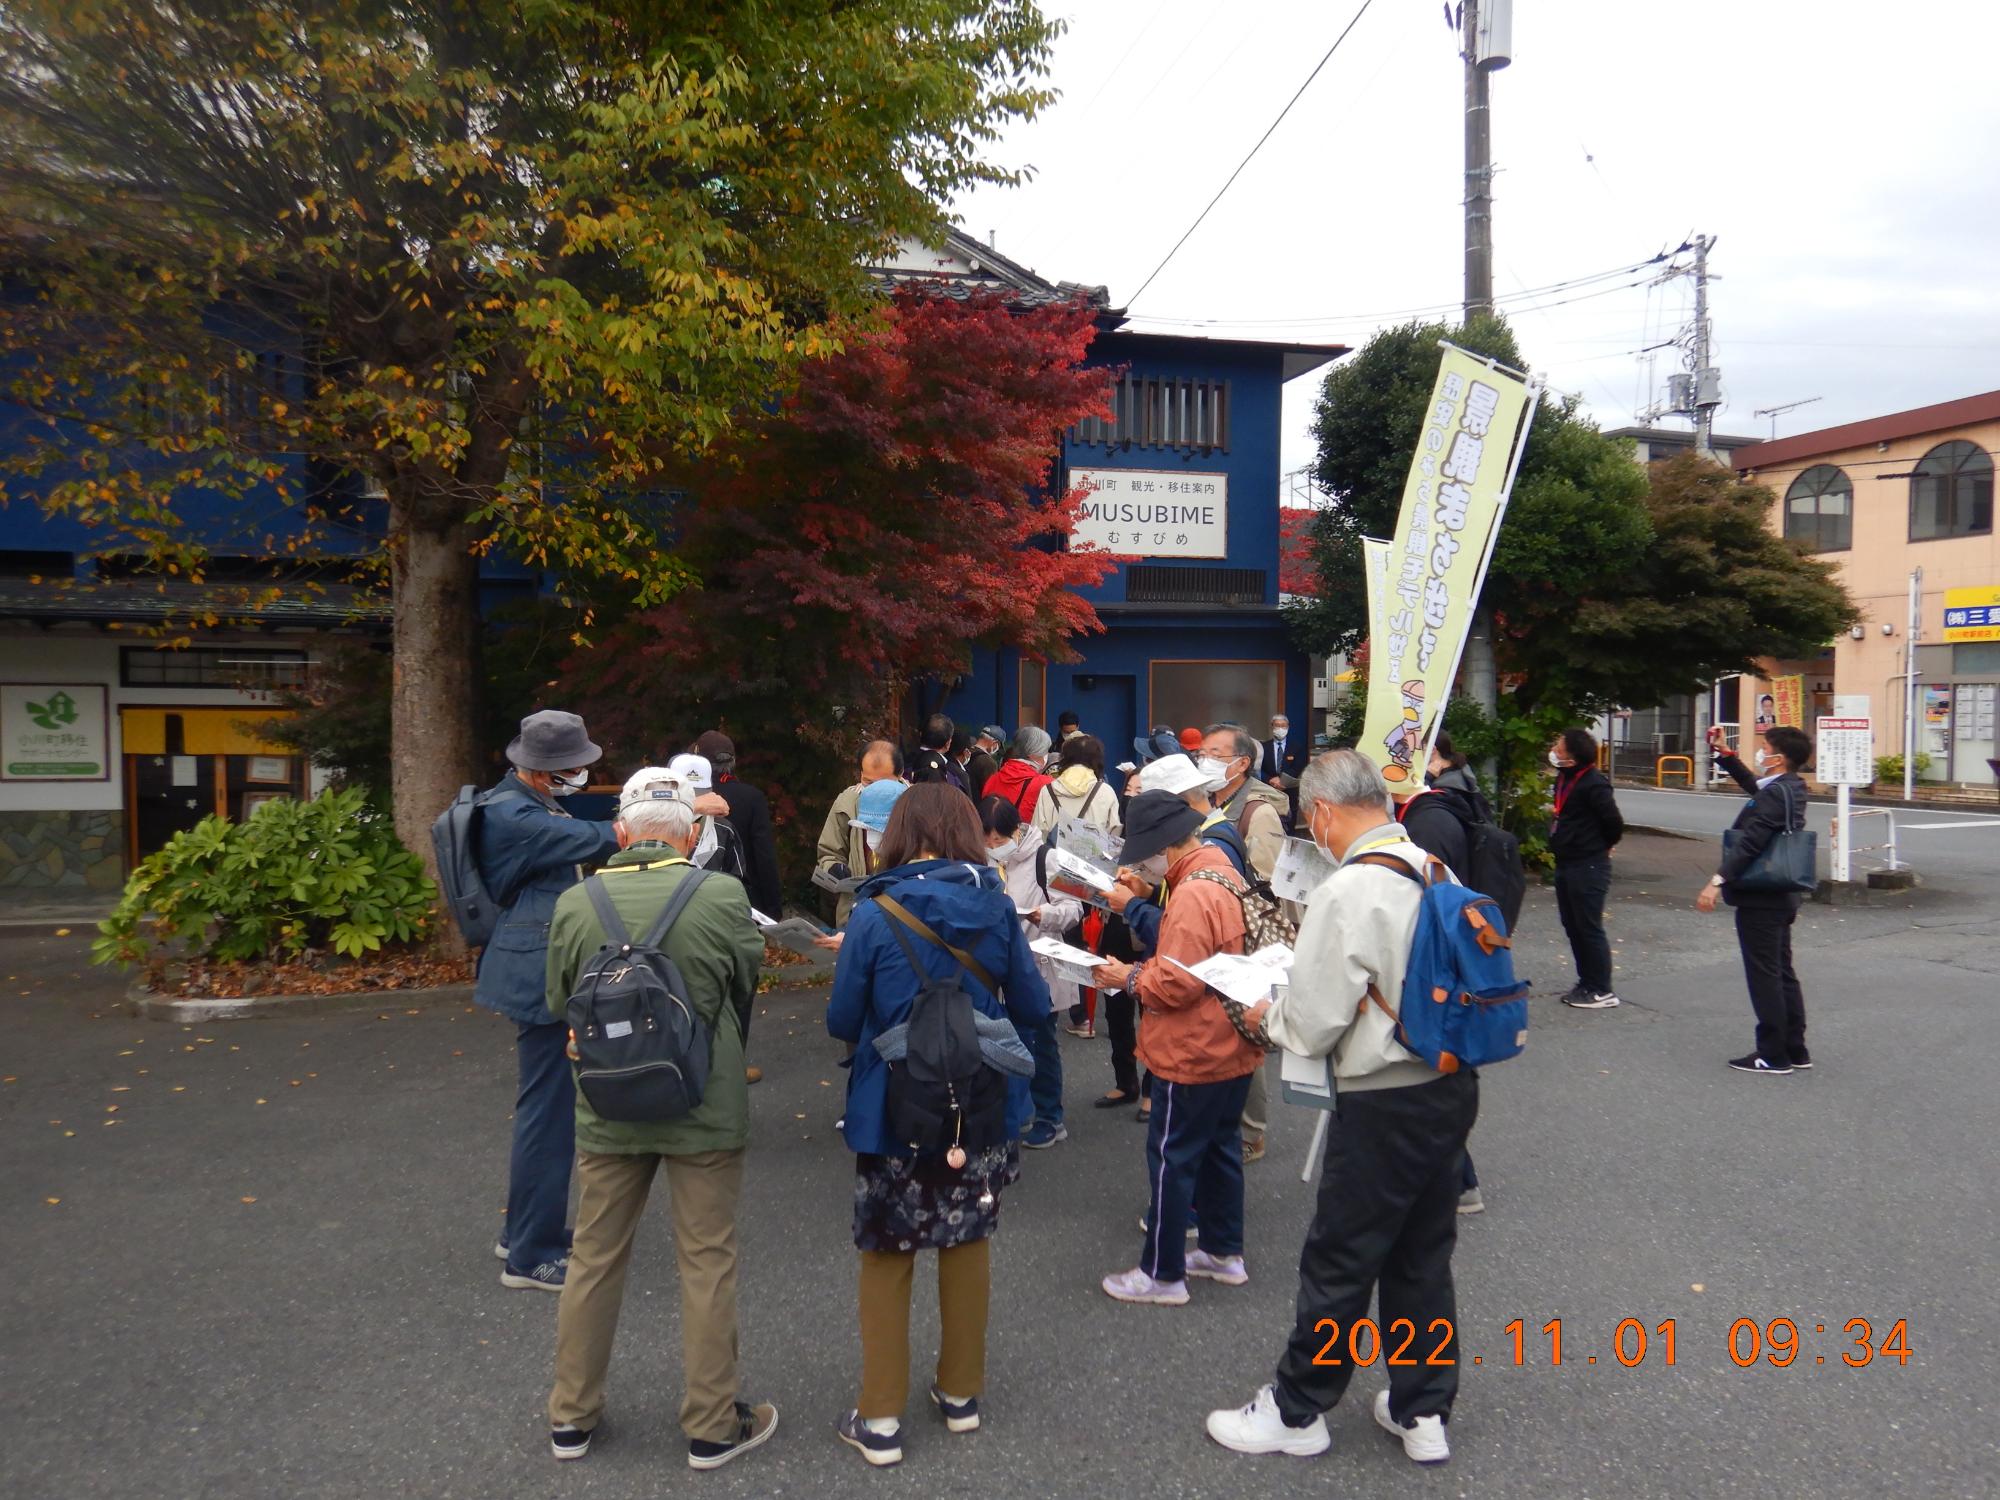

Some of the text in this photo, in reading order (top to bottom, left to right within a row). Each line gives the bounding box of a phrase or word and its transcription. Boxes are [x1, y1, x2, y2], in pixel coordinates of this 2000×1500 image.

[1131, 480, 1215, 495] 観光・移住案内
[1081, 503, 1215, 525] MUSUBIME
[1108, 531, 1188, 546] むすびめ
